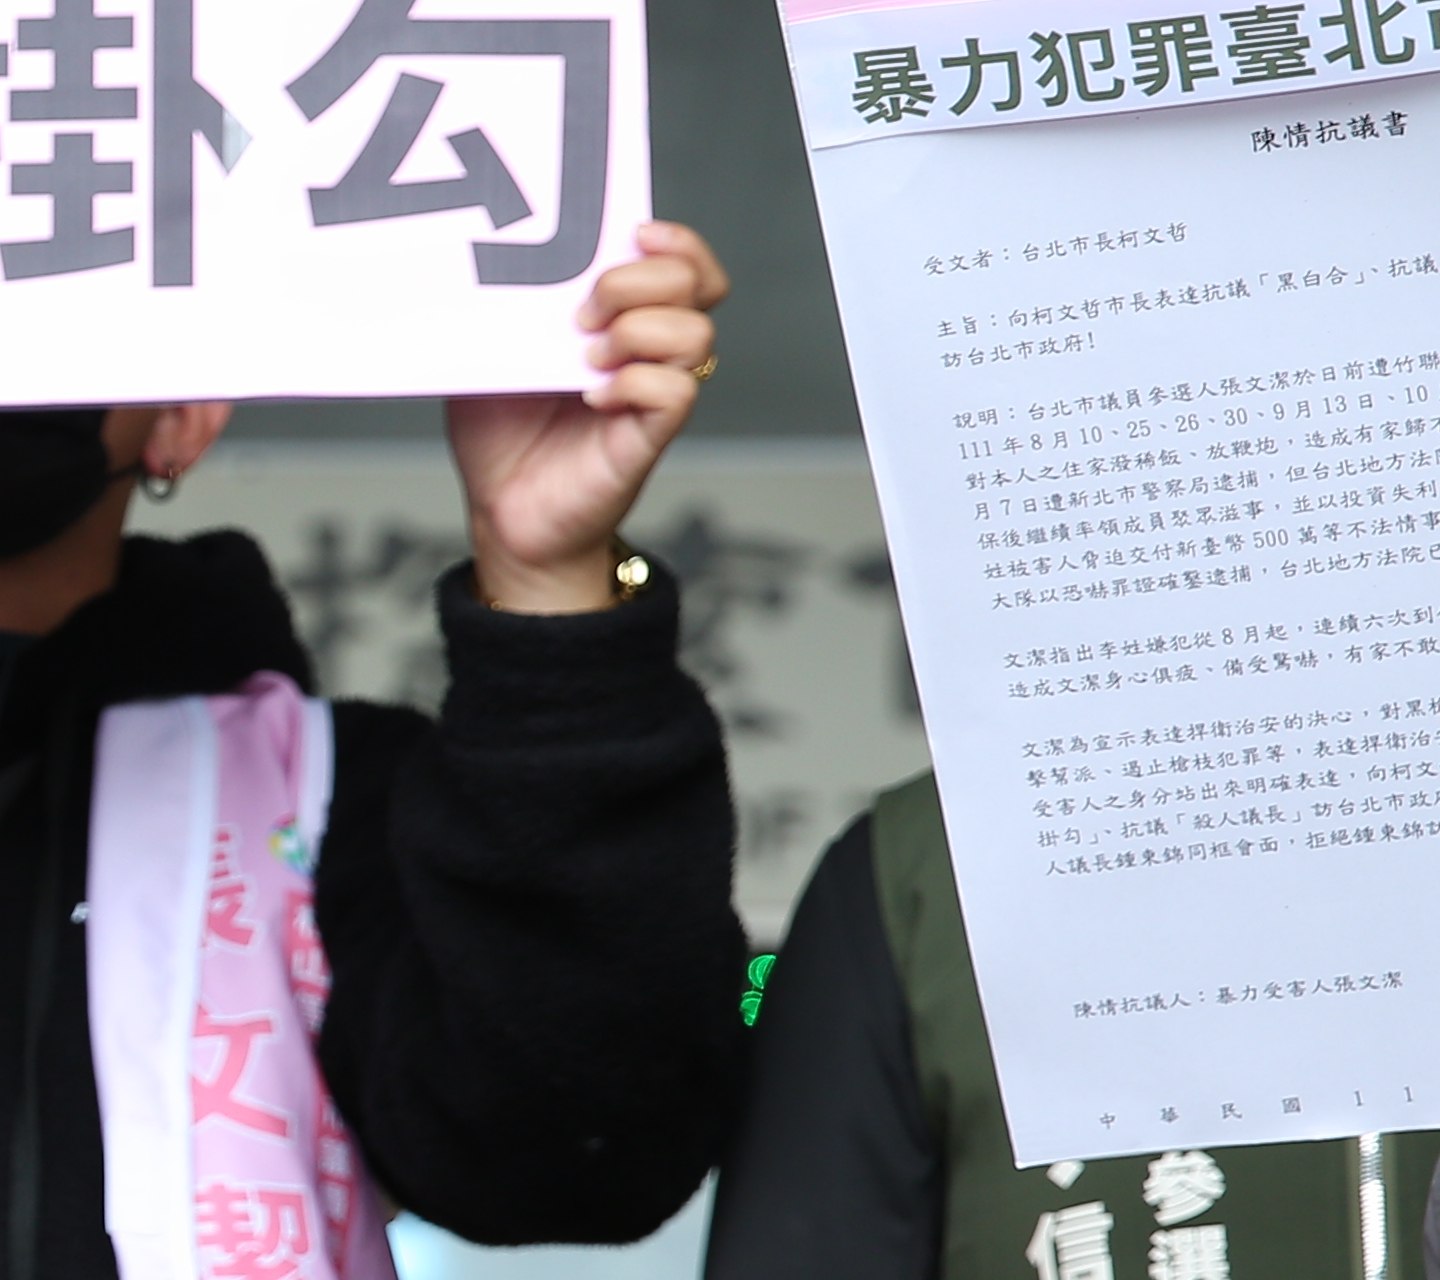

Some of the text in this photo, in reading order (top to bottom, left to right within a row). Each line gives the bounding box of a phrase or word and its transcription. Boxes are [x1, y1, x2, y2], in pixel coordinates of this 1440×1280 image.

[1251, 111, 1408, 152] 陳情抗議書
